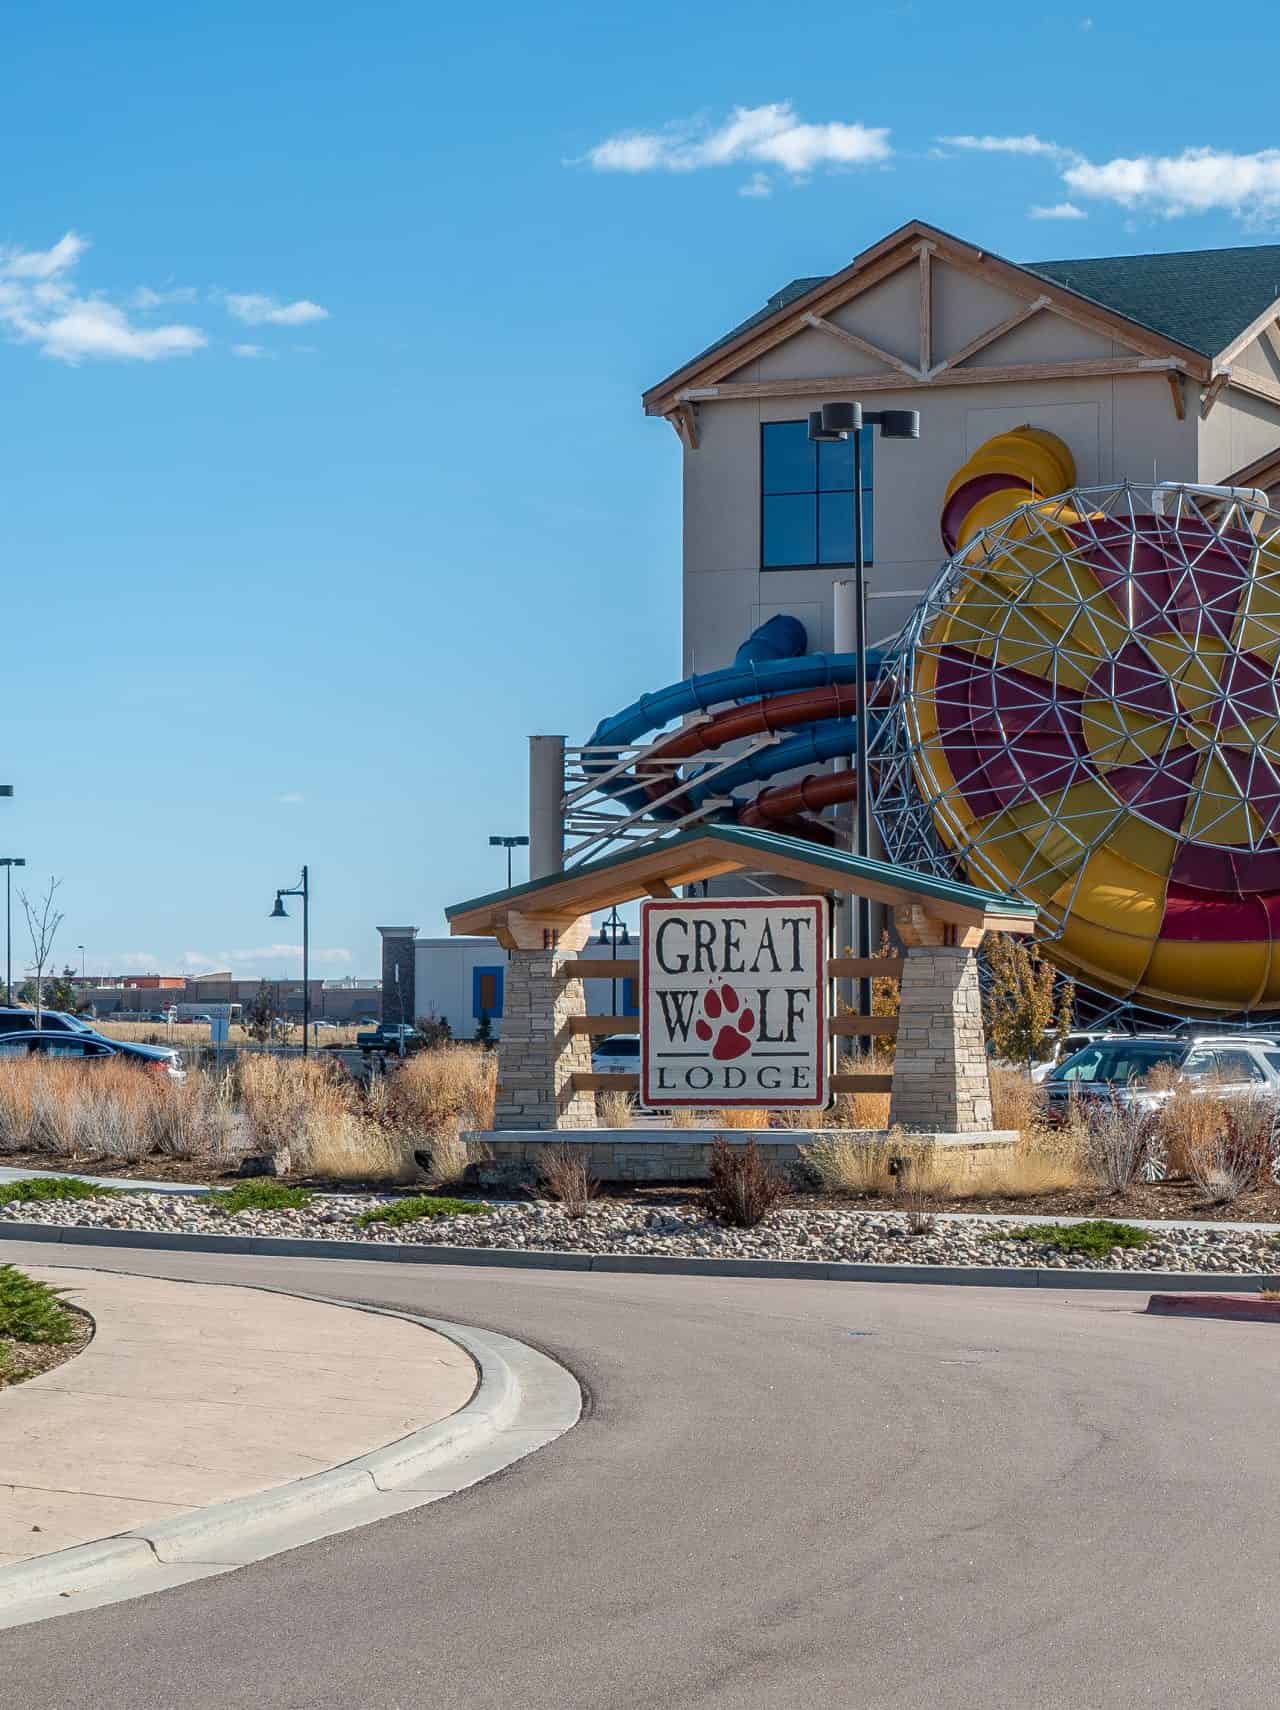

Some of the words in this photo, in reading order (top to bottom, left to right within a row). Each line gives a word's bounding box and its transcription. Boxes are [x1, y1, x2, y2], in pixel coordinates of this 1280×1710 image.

[655, 917, 812, 975] GREAT
[655, 988, 811, 1044] WLF
[656, 1065, 811, 1090] LODGE
